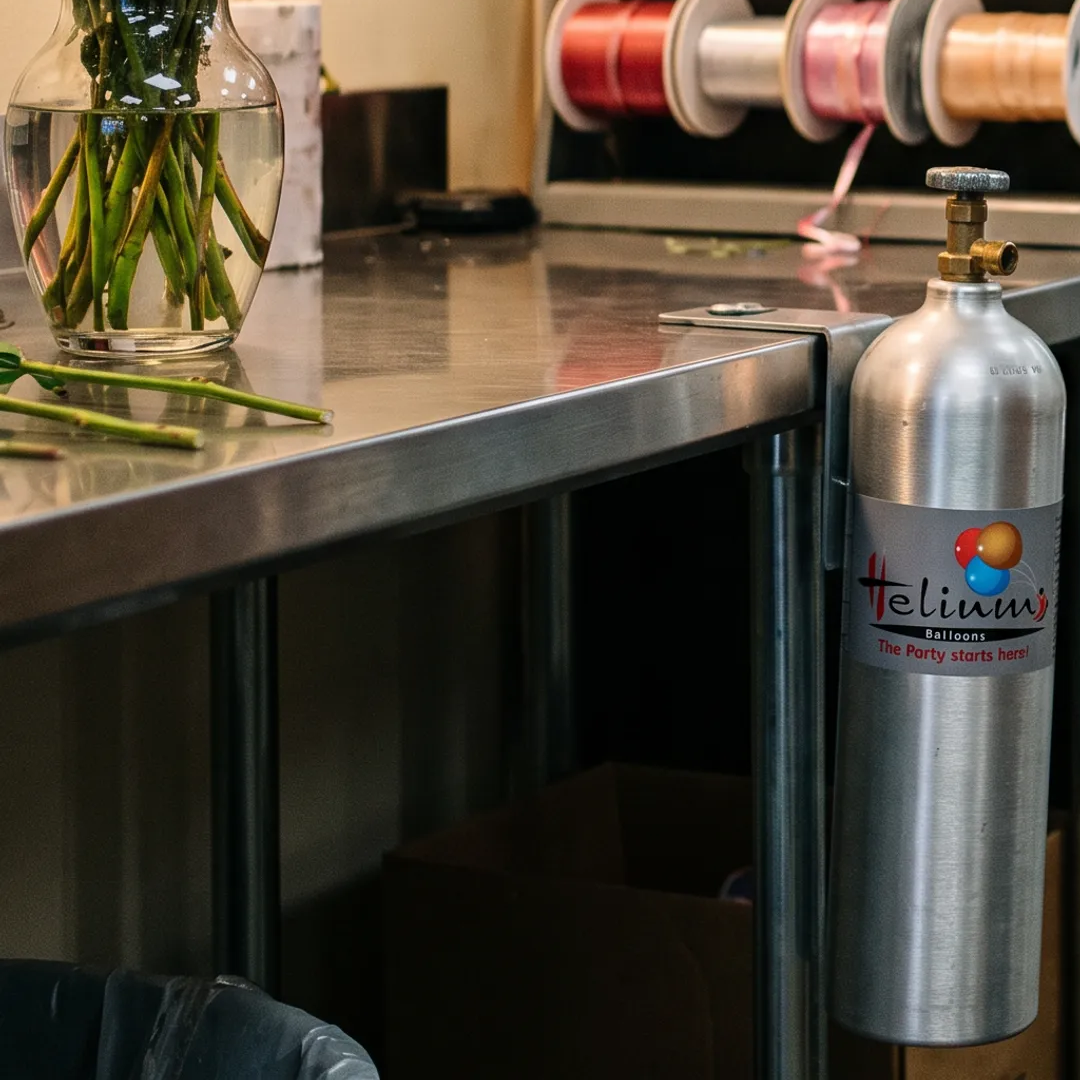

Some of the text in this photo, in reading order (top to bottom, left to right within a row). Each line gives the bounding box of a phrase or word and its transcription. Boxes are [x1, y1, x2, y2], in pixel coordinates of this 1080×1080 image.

[925, 628, 986, 642] Balloons
[878, 638, 901, 656] The
[906, 643, 946, 664] Party
[950, 649, 994, 662] starts
